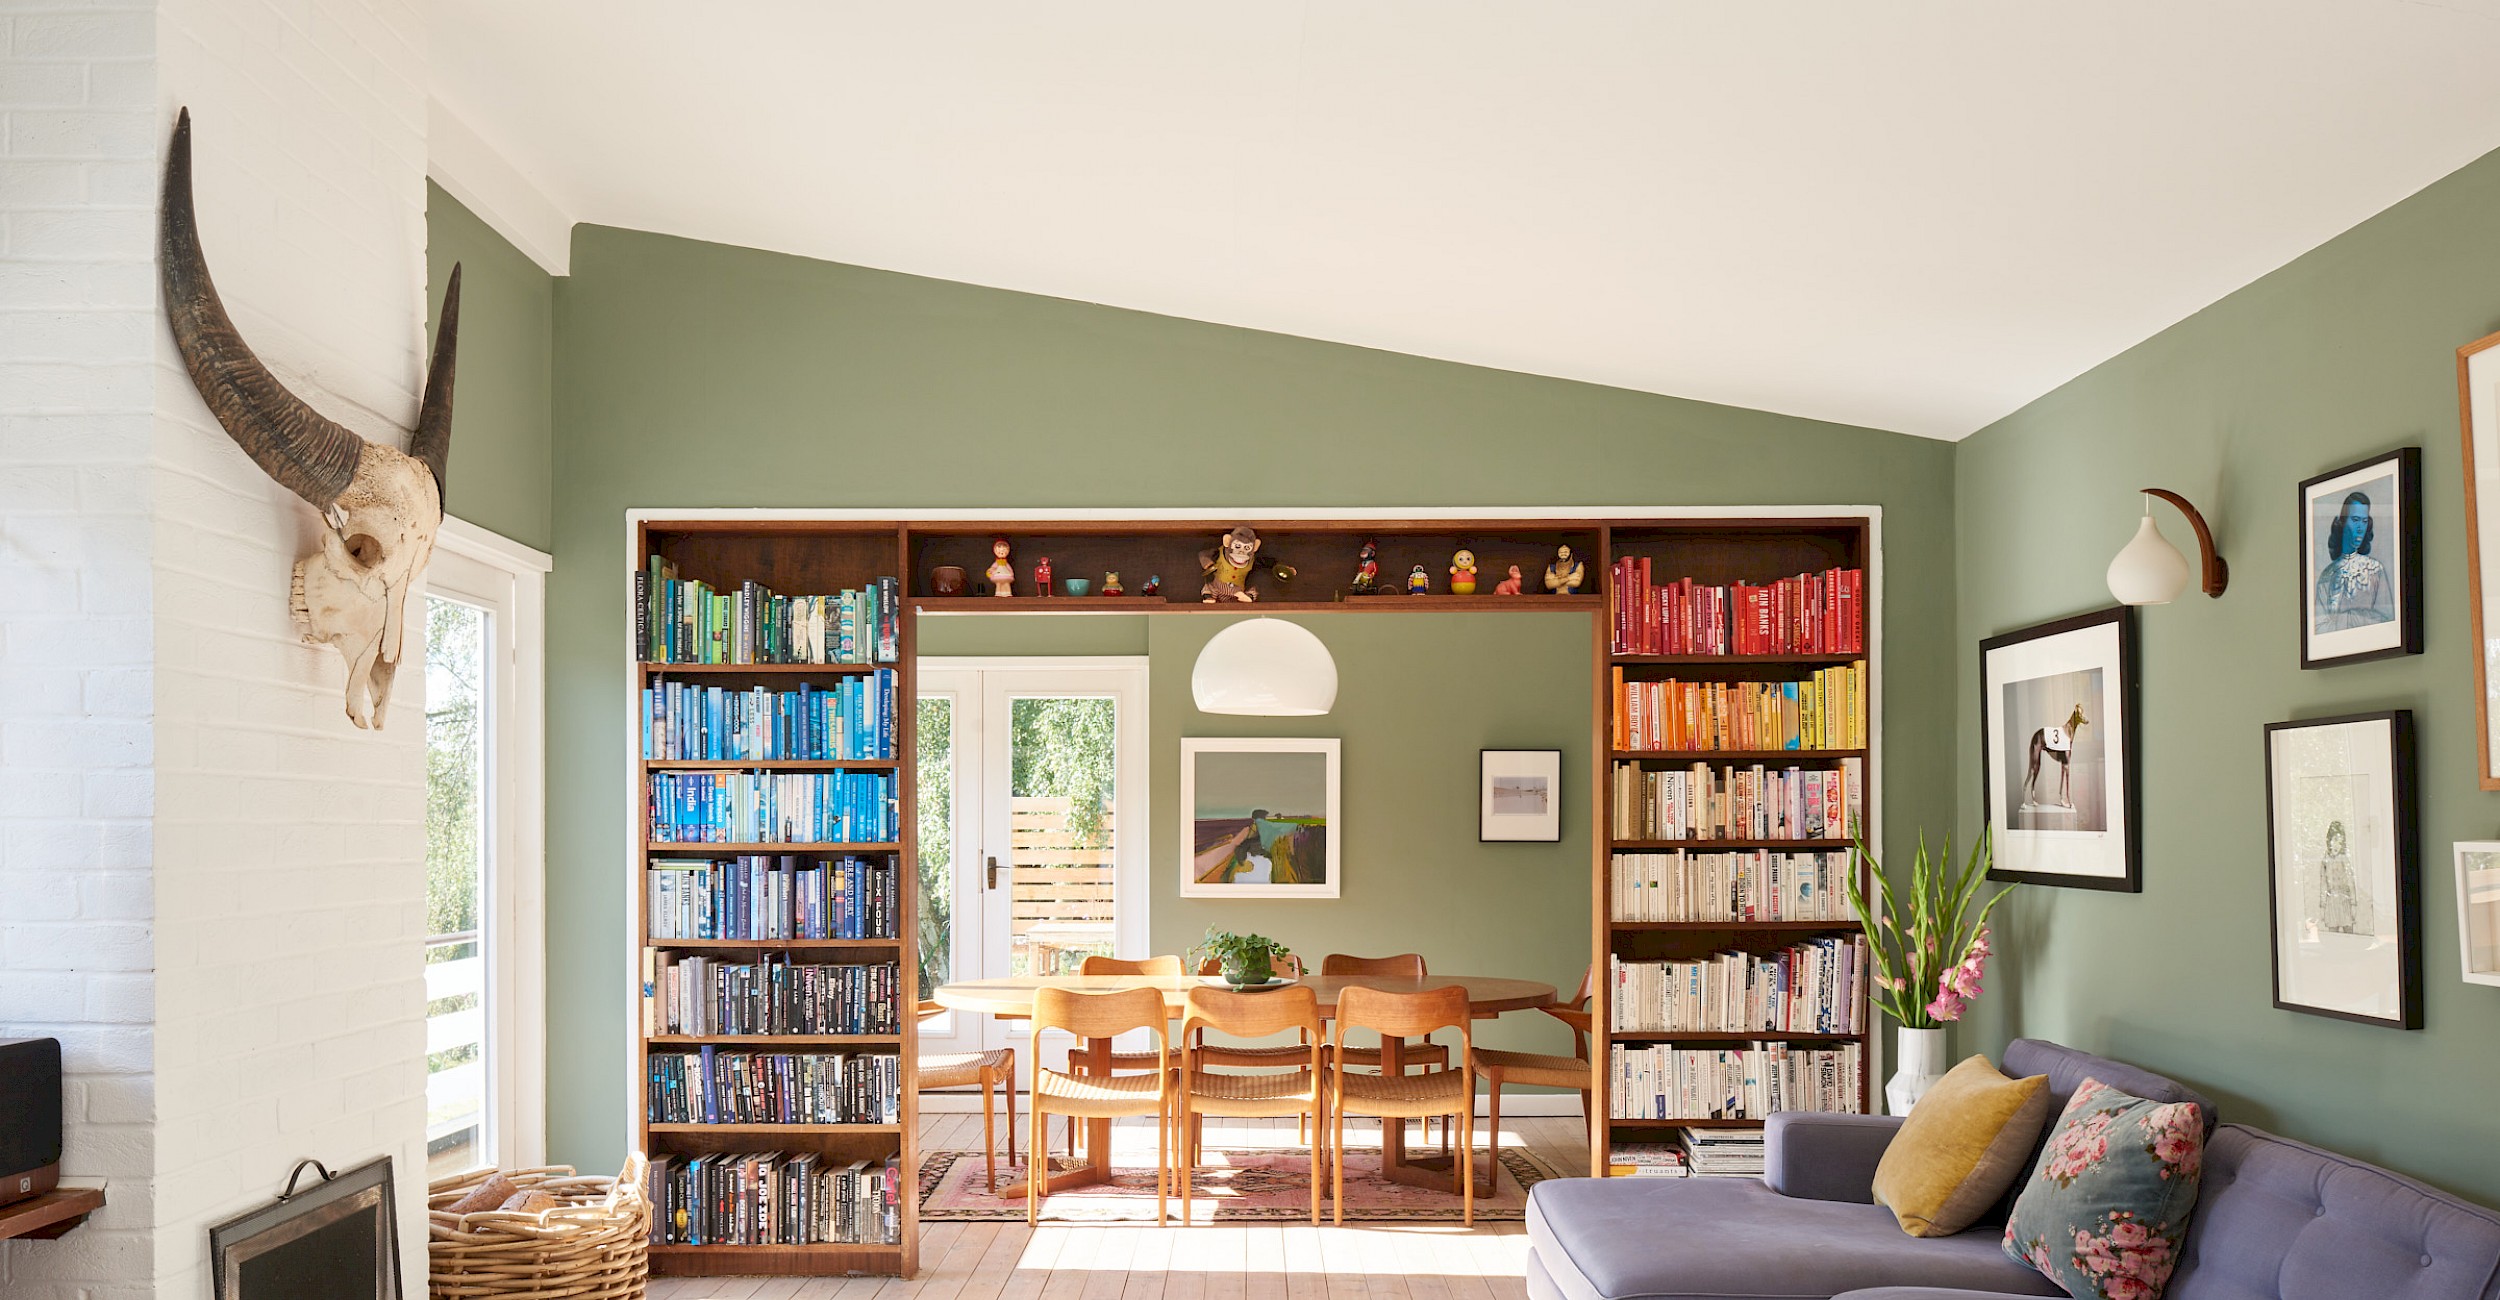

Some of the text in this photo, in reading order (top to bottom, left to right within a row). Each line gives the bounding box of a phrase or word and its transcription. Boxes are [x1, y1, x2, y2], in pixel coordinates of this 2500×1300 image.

[637, 576, 645, 600] FLORA
[1662, 589, 1670, 606] LUCKY
[1758, 590, 1769, 636] IAIN BANKS
[1630, 683, 1639, 713] WILLIAM
[2053, 729, 2060, 745] 3
[687, 787, 697, 812] India
[1690, 966, 1698, 996] MR BLUE
[758, 1179, 768, 1204] JOE
[886, 1167, 899, 1205] Cartel
[758, 1205, 768, 1230] IDE
